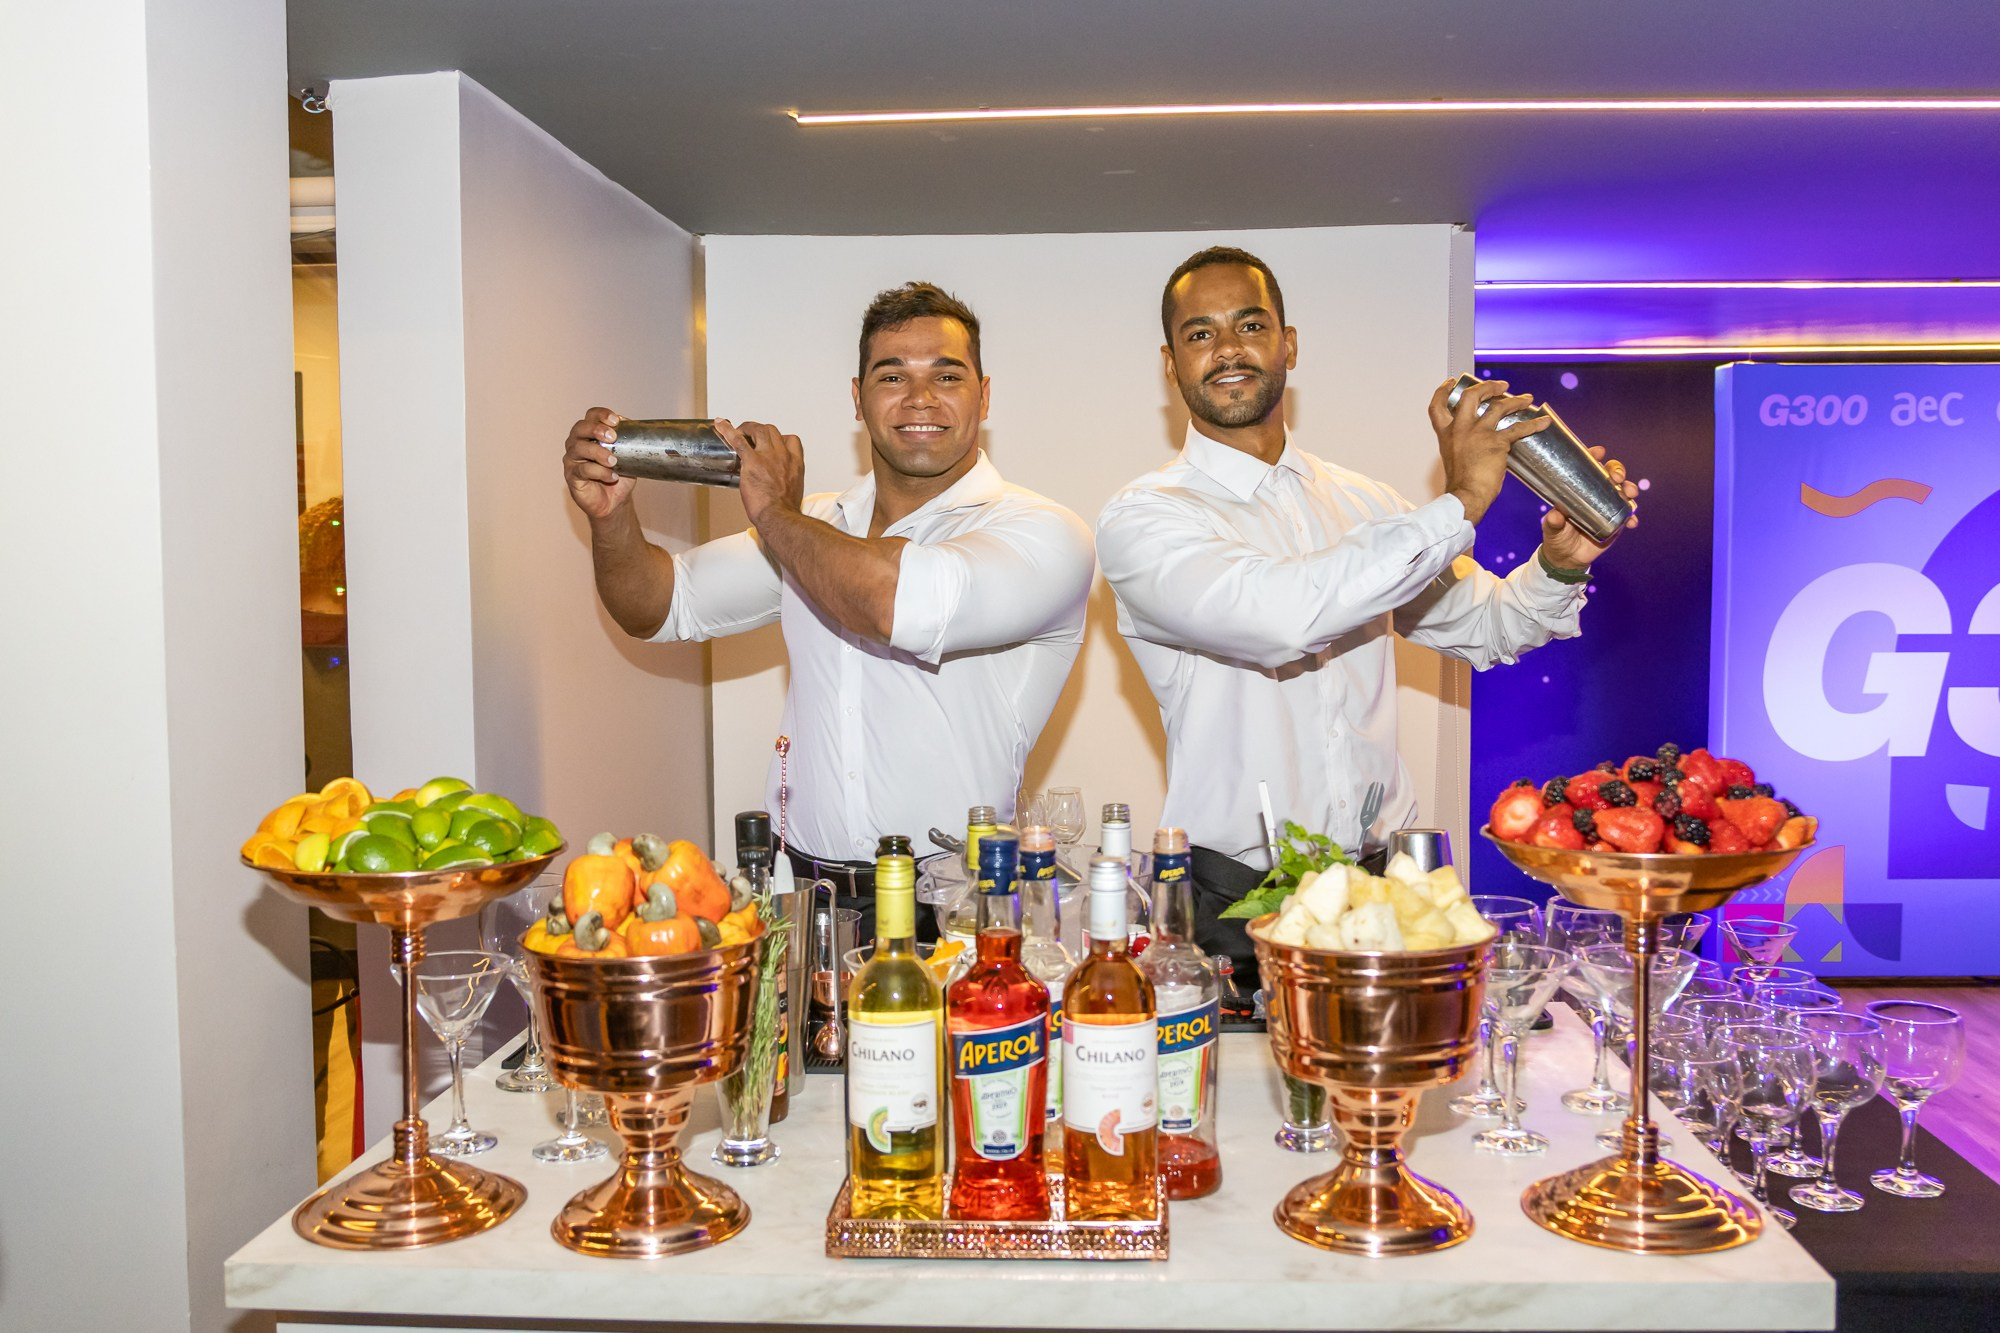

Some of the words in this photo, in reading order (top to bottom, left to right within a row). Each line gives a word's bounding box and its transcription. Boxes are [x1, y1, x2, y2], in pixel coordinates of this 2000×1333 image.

[1759, 394, 1868, 427] G300
[1890, 392, 1965, 426] aeC
[852, 1041, 915, 1061] CHILANO
[960, 1031, 1039, 1070] APEROL
[1076, 1045, 1145, 1063] CHILANO
